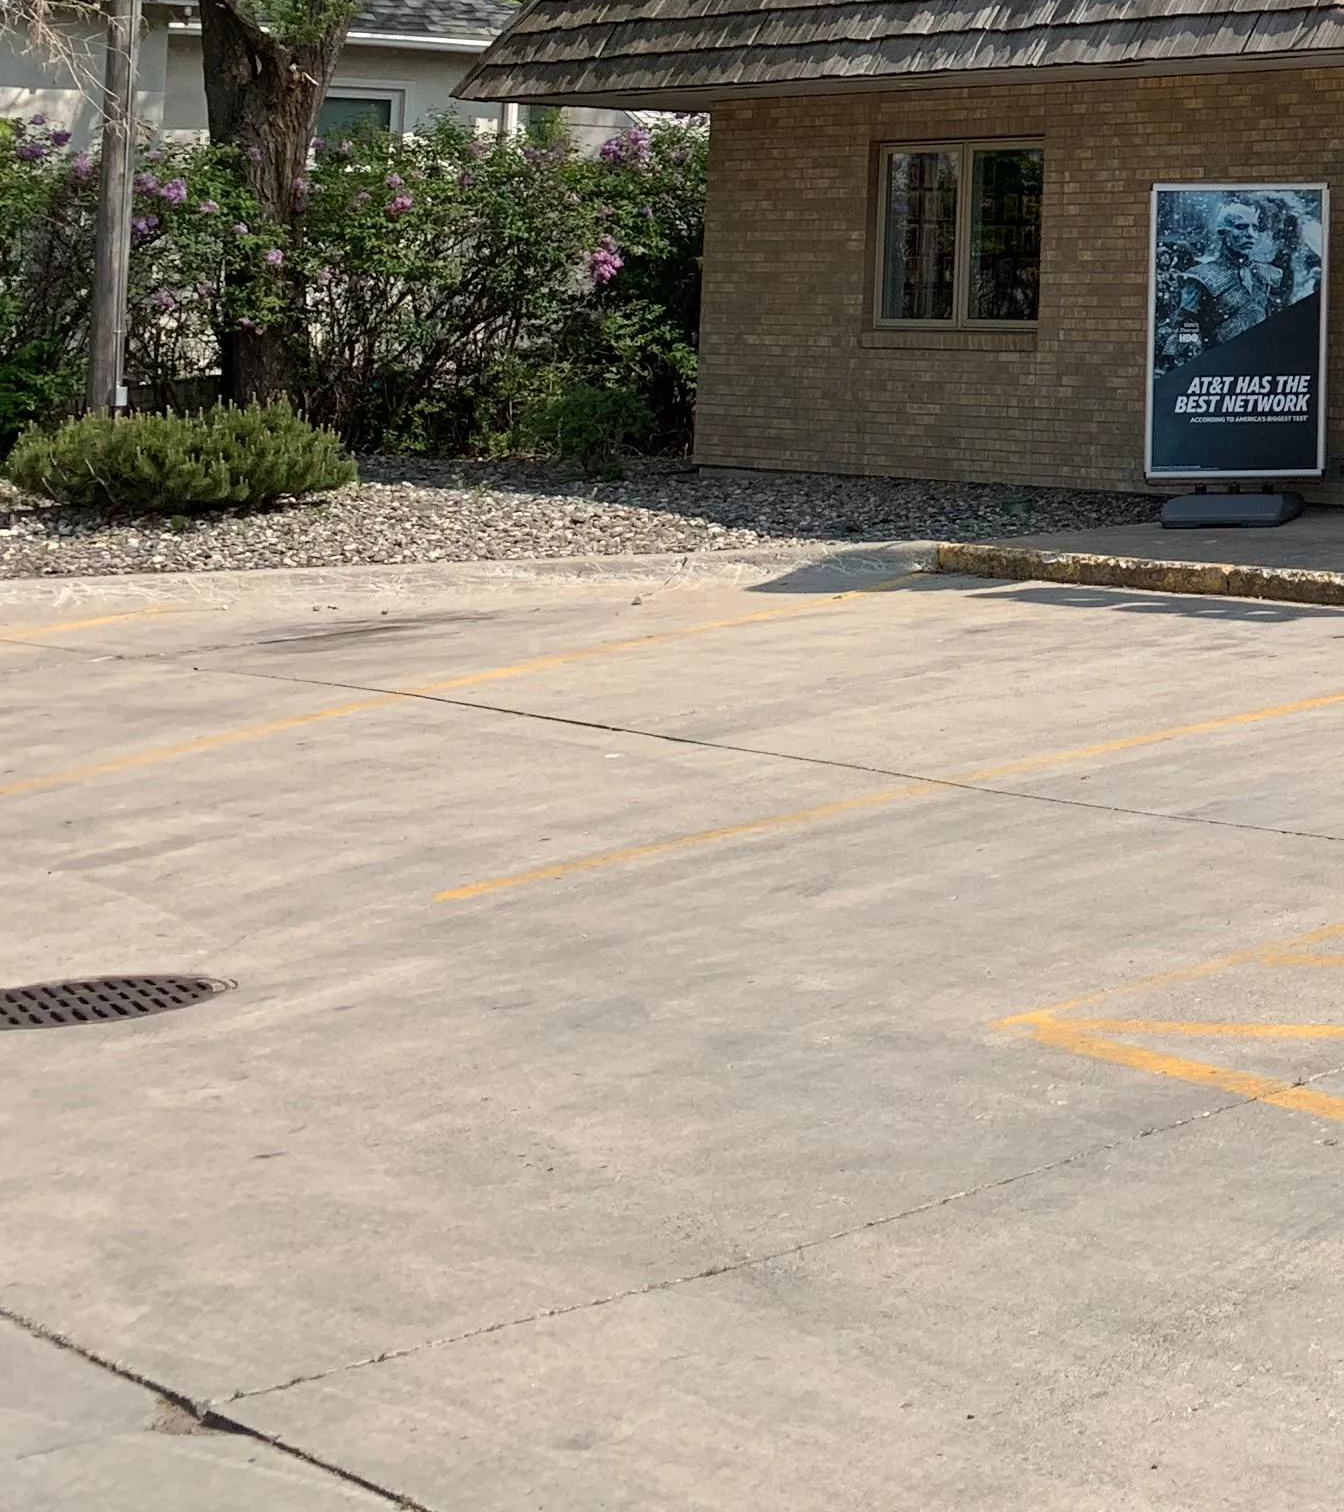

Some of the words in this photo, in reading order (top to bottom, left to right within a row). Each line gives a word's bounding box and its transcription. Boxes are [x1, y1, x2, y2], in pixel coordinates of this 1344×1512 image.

[1187, 376, 1235, 394] AT&T
[1235, 376, 1272, 394] HAS
[1276, 375, 1311, 393] THE
[1174, 395, 1221, 413] BEST
[1221, 394, 1311, 413] NETWORK
